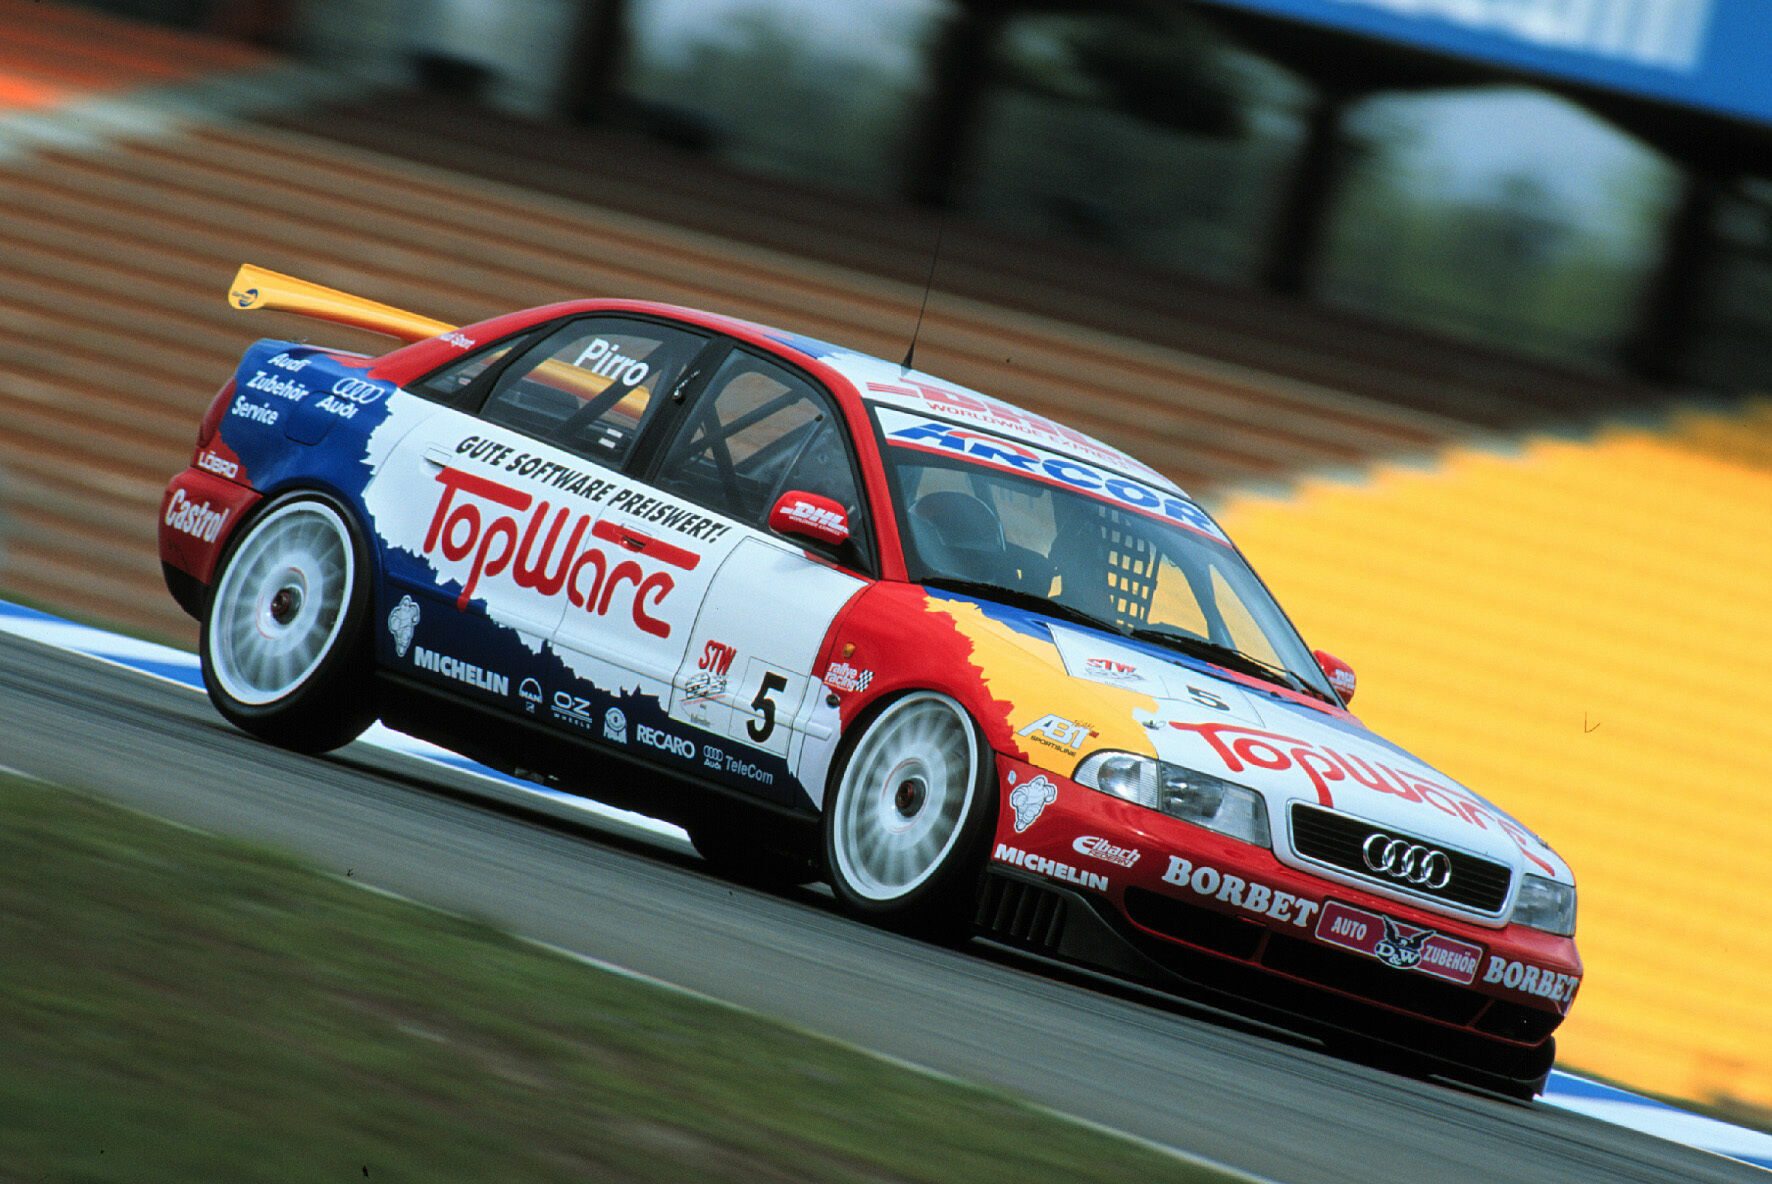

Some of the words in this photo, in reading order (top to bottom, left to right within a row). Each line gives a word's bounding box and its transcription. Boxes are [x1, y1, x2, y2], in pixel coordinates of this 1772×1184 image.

[267, 352, 312, 373] Audi
[574, 337, 649, 386] Pirro
[246, 370, 309, 402] Zubehör
[231, 394, 279, 425] Service
[315, 395, 360, 419] Audi
[925, 400, 1043, 438] WORLDWIDE
[455, 435, 512, 468] GUTE
[504, 452, 613, 503] SOFTWARE
[606, 488, 733, 544] PREISWERT!
[887, 422, 1214, 536] ARCOR
[165, 488, 230, 544] Castrol
[792, 500, 845, 532] DHL
[423, 466, 701, 639] TopWare
[414, 646, 509, 697] MICHELIN
[698, 639, 737, 676] STW
[828, 662, 858, 680] rallye
[1086, 658, 1137, 674] STW
[823, 671, 860, 692] racing
[1186, 684, 1231, 711] 5
[746, 671, 788, 743] 5
[636, 724, 696, 760] RECARO
[1016, 713, 1091, 750] ABT
[725, 755, 774, 785] TeleCom
[994, 843, 1109, 892] MICHELIN
[1161, 855, 1320, 928] BORBET
[1331, 915, 1368, 941] AUTO
[1423, 942, 1477, 975] ZUBEHÖR
[1483, 955, 1580, 1003] BORBET
